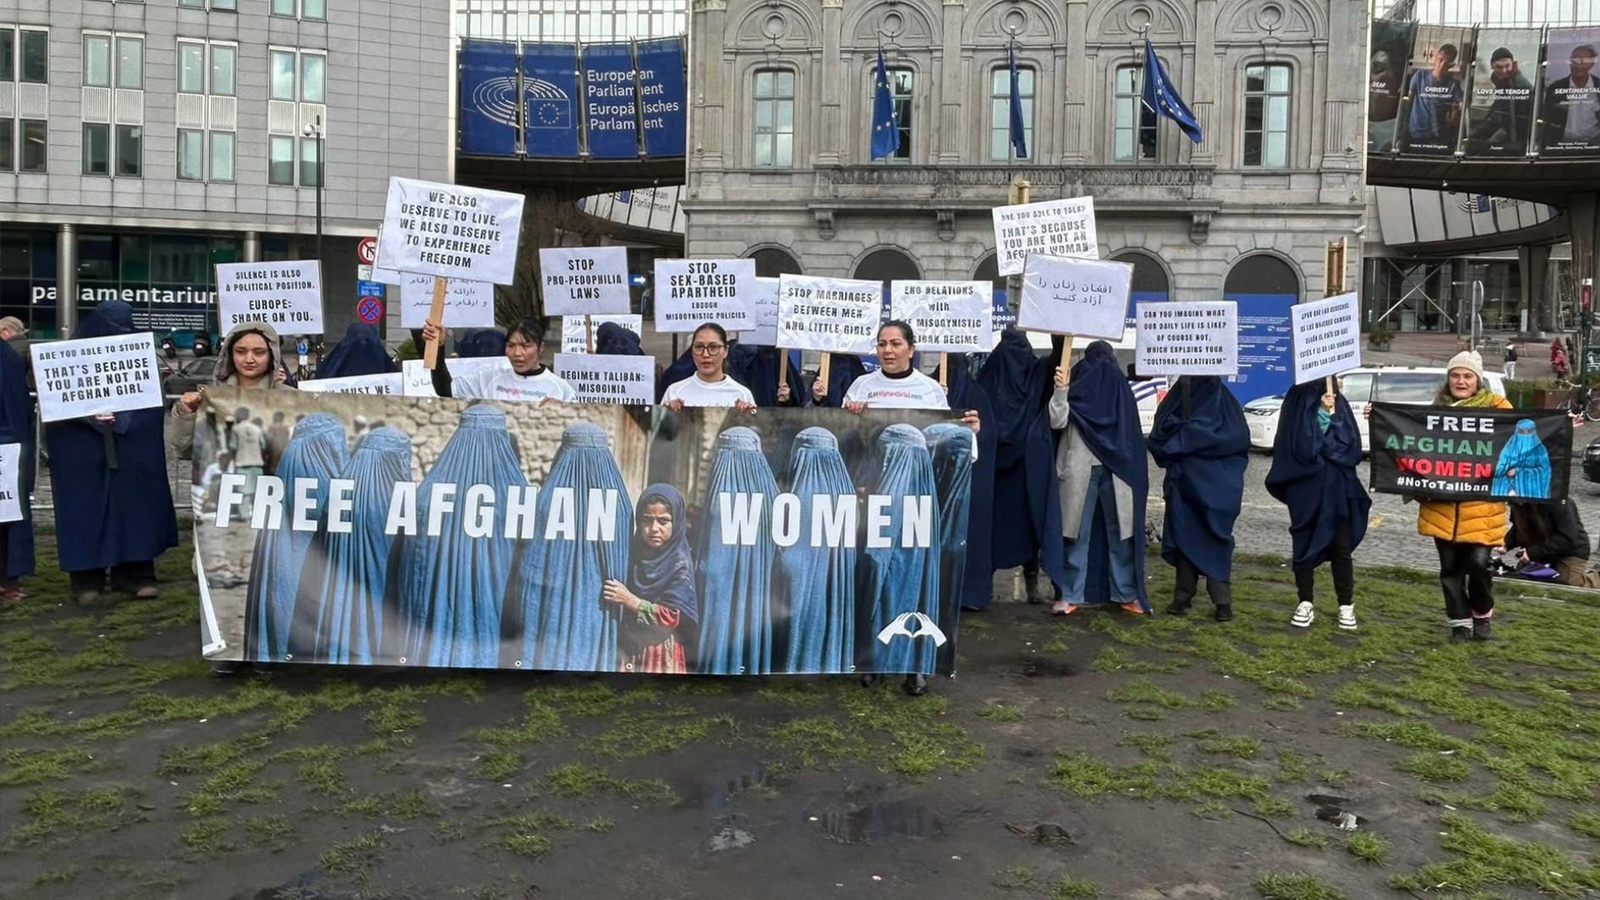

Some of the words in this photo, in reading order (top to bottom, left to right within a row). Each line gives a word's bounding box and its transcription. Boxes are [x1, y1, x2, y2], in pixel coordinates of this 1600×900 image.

[587, 69, 653, 83] European
[588, 83, 663, 97] Parliament
[589, 100, 679, 117] Europäisches
[590, 118, 664, 130] Parlament
[429, 192, 445, 203] WE
[450, 195, 477, 208] ALSO
[402, 204, 450, 219] DESERVE
[455, 211, 467, 221] TO
[472, 213, 499, 227] LIVE.
[400, 218, 416, 230] WE
[420, 222, 448, 234] ALSO
[453, 226, 501, 241] DESERVE
[1002, 225, 1037, 238] THAT'S
[1041, 220, 1086, 234] BECAUSE
[407, 235, 419, 245] TO
[425, 237, 491, 255] EXPERIENCE
[1004, 239, 1022, 249] YOU
[1027, 236, 1045, 247] ARE
[1050, 233, 1068, 244] NOT
[1074, 231, 1087, 242] AN
[1050, 242, 1089, 254] WOMAN
[420, 252, 472, 268] FREEDOM
[568, 259, 595, 271] STOP
[236, 271, 267, 280] SILENCE
[270, 270, 278, 278] IS
[282, 270, 301, 278] ALSO
[689, 263, 718, 274] STOP
[226, 284, 231, 292] A
[234, 283, 273, 291] POLITICAL
[276, 282, 315, 290] POSITION.
[547, 275, 622, 285] PRO-PEDOPHILIA
[671, 274, 736, 286] SEX-BASED
[1039, 278, 1047, 288] را
[32, 284, 217, 304] palamentariu
[570, 288, 600, 299] LAWS
[672, 287, 736, 298] APARTHEID
[788, 288, 812, 298] STOP
[816, 290, 872, 303] MARRIAGES
[905, 286, 922, 295] END
[926, 286, 974, 295] RELATIONS
[249, 300, 292, 310] EUROPE:
[794, 305, 837, 317] BETWEEN
[842, 309, 863, 319] MEN
[928, 303, 949, 312] with
[232, 313, 268, 324] SHAME
[272, 312, 285, 322] ON
[290, 312, 313, 321] YOU.
[917, 319, 981, 328] MISOGYNISTIC
[786, 322, 804, 331] AND
[809, 322, 839, 333] LITTLE
[844, 326, 872, 336] GIRLS
[914, 336, 940, 344] LIBAN
[944, 336, 978, 344] REGIME
[40, 352, 56, 361] ARE
[60, 350, 77, 358] YOU
[81, 347, 102, 356] ABLE
[120, 342, 151, 351] STUDY?
[44, 364, 89, 379] THAT'S
[95, 358, 149, 373] BECAUSE
[47, 379, 71, 391] YOU
[78, 376, 100, 388] ARE
[106, 373, 128, 384] NOT
[134, 370, 150, 380] AN
[62, 387, 110, 403] AFGHAN
[116, 383, 144, 396] GIRL
[375, 385, 391, 394] WE
[578, 384, 626, 394] MISOGINIA
[1427, 416, 1495, 433] FREE
[1385, 434, 1493, 456] AFGHAN
[1396, 457, 1492, 478] WOMEN
[1398, 477, 1488, 491] #NoToTaliban
[215, 474, 355, 533] FREE
[386, 481, 619, 542] AFGHAN
[719, 492, 932, 548] WOMEN
